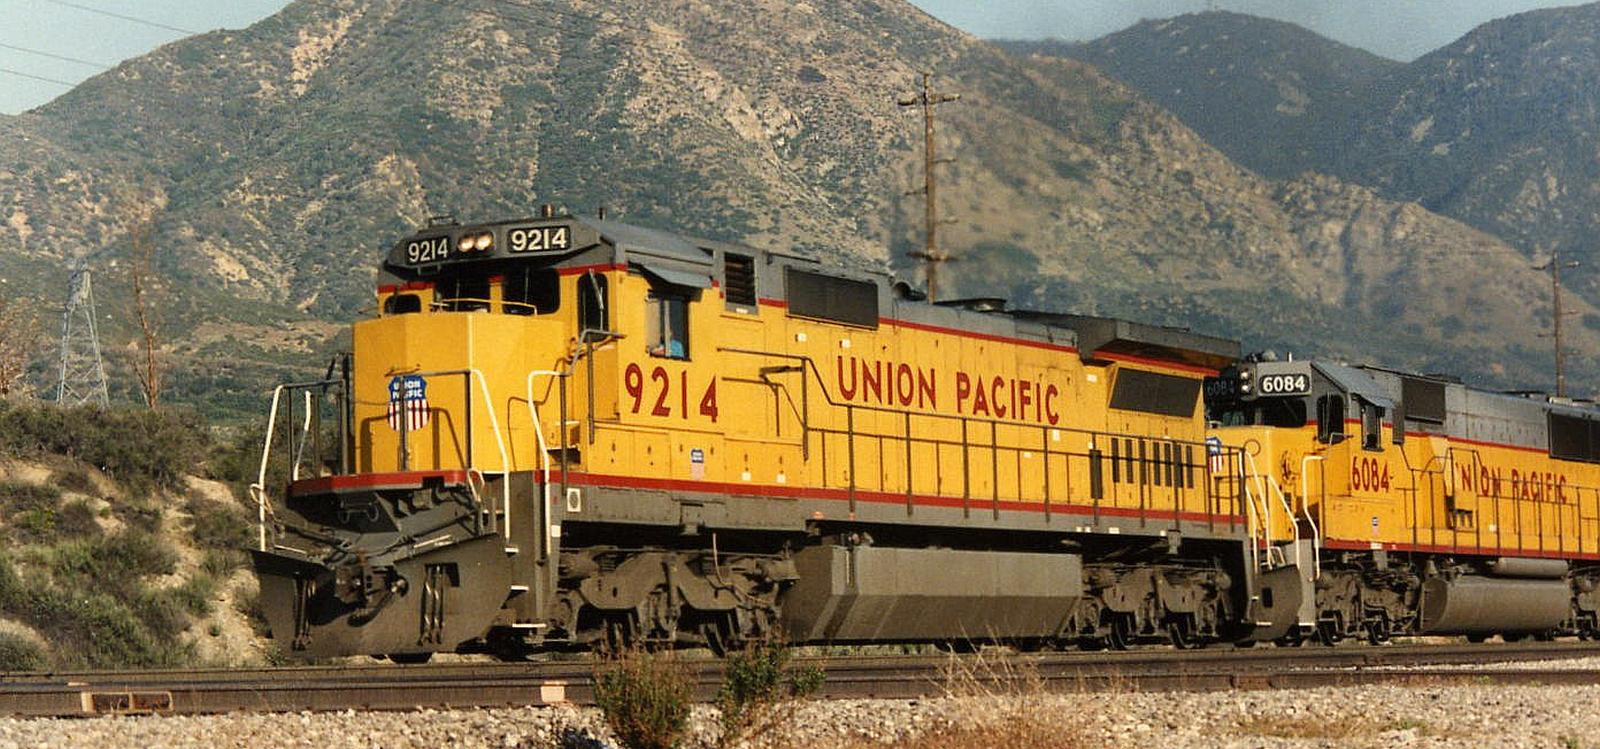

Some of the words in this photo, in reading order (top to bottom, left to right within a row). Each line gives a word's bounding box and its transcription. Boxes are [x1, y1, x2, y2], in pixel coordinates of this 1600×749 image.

[408, 238, 449, 263] 9214
[511, 227, 567, 252] 9214
[624, 362, 718, 423] 9214
[837, 355, 937, 411] UNION
[956, 371, 1059, 426] PACIFIC
[1262, 375, 1306, 393] 6084
[1351, 456, 1390, 493] 6084
[1511, 468, 1567, 505] PACIFIC
